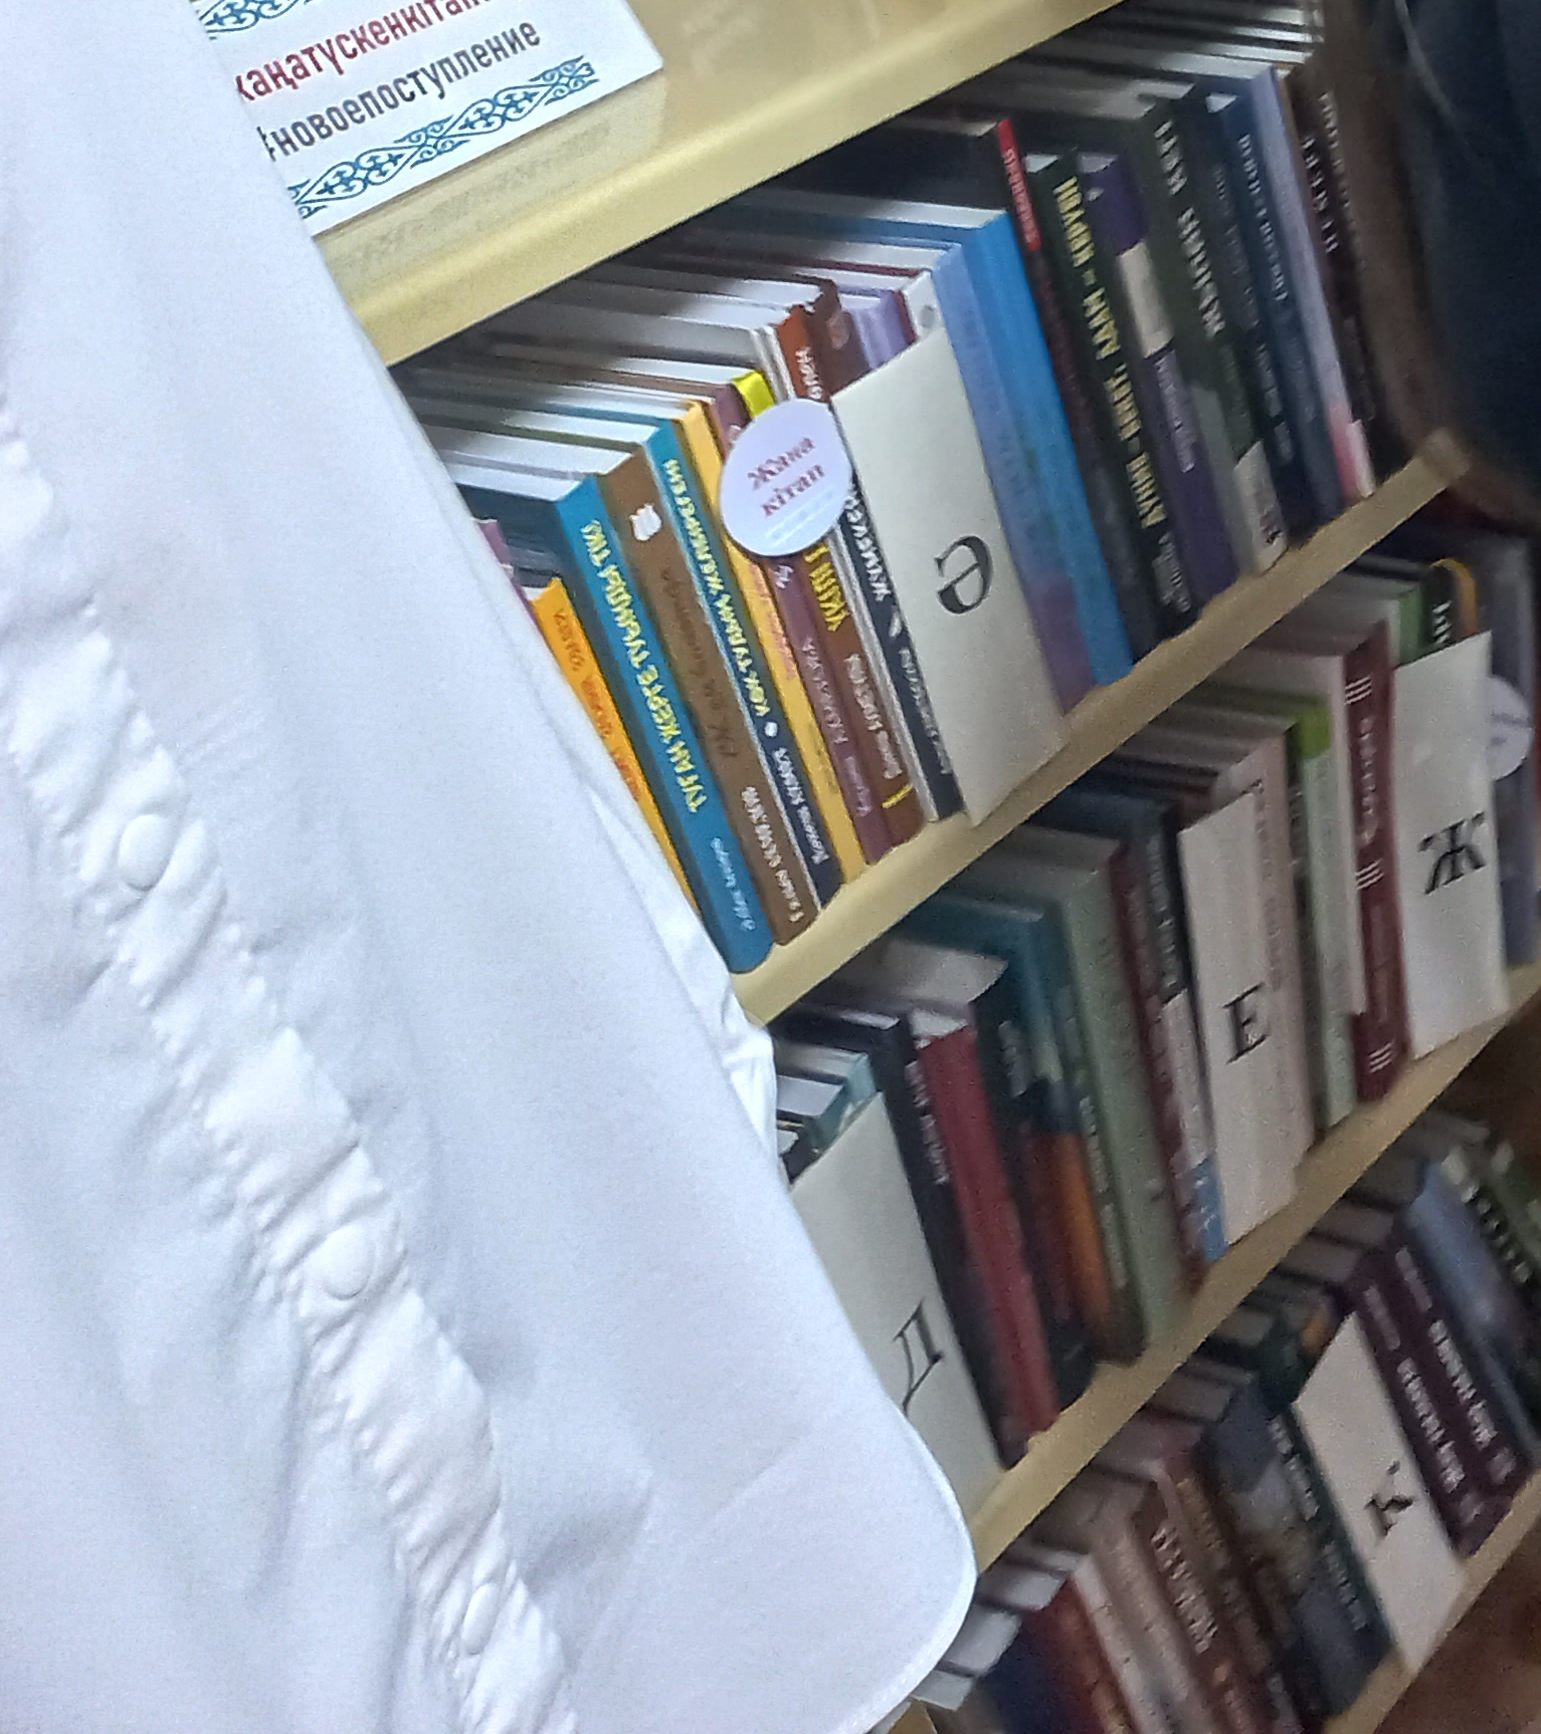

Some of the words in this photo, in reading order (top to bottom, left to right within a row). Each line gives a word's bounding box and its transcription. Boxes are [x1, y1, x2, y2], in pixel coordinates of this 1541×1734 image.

[937, 533, 992, 615] Ә
[631, 663, 682, 745] ЖЕРГЕ
[1419, 813, 1488, 895] Ж
[1226, 987, 1267, 1063] Е
[893, 1301, 945, 1408] Д
